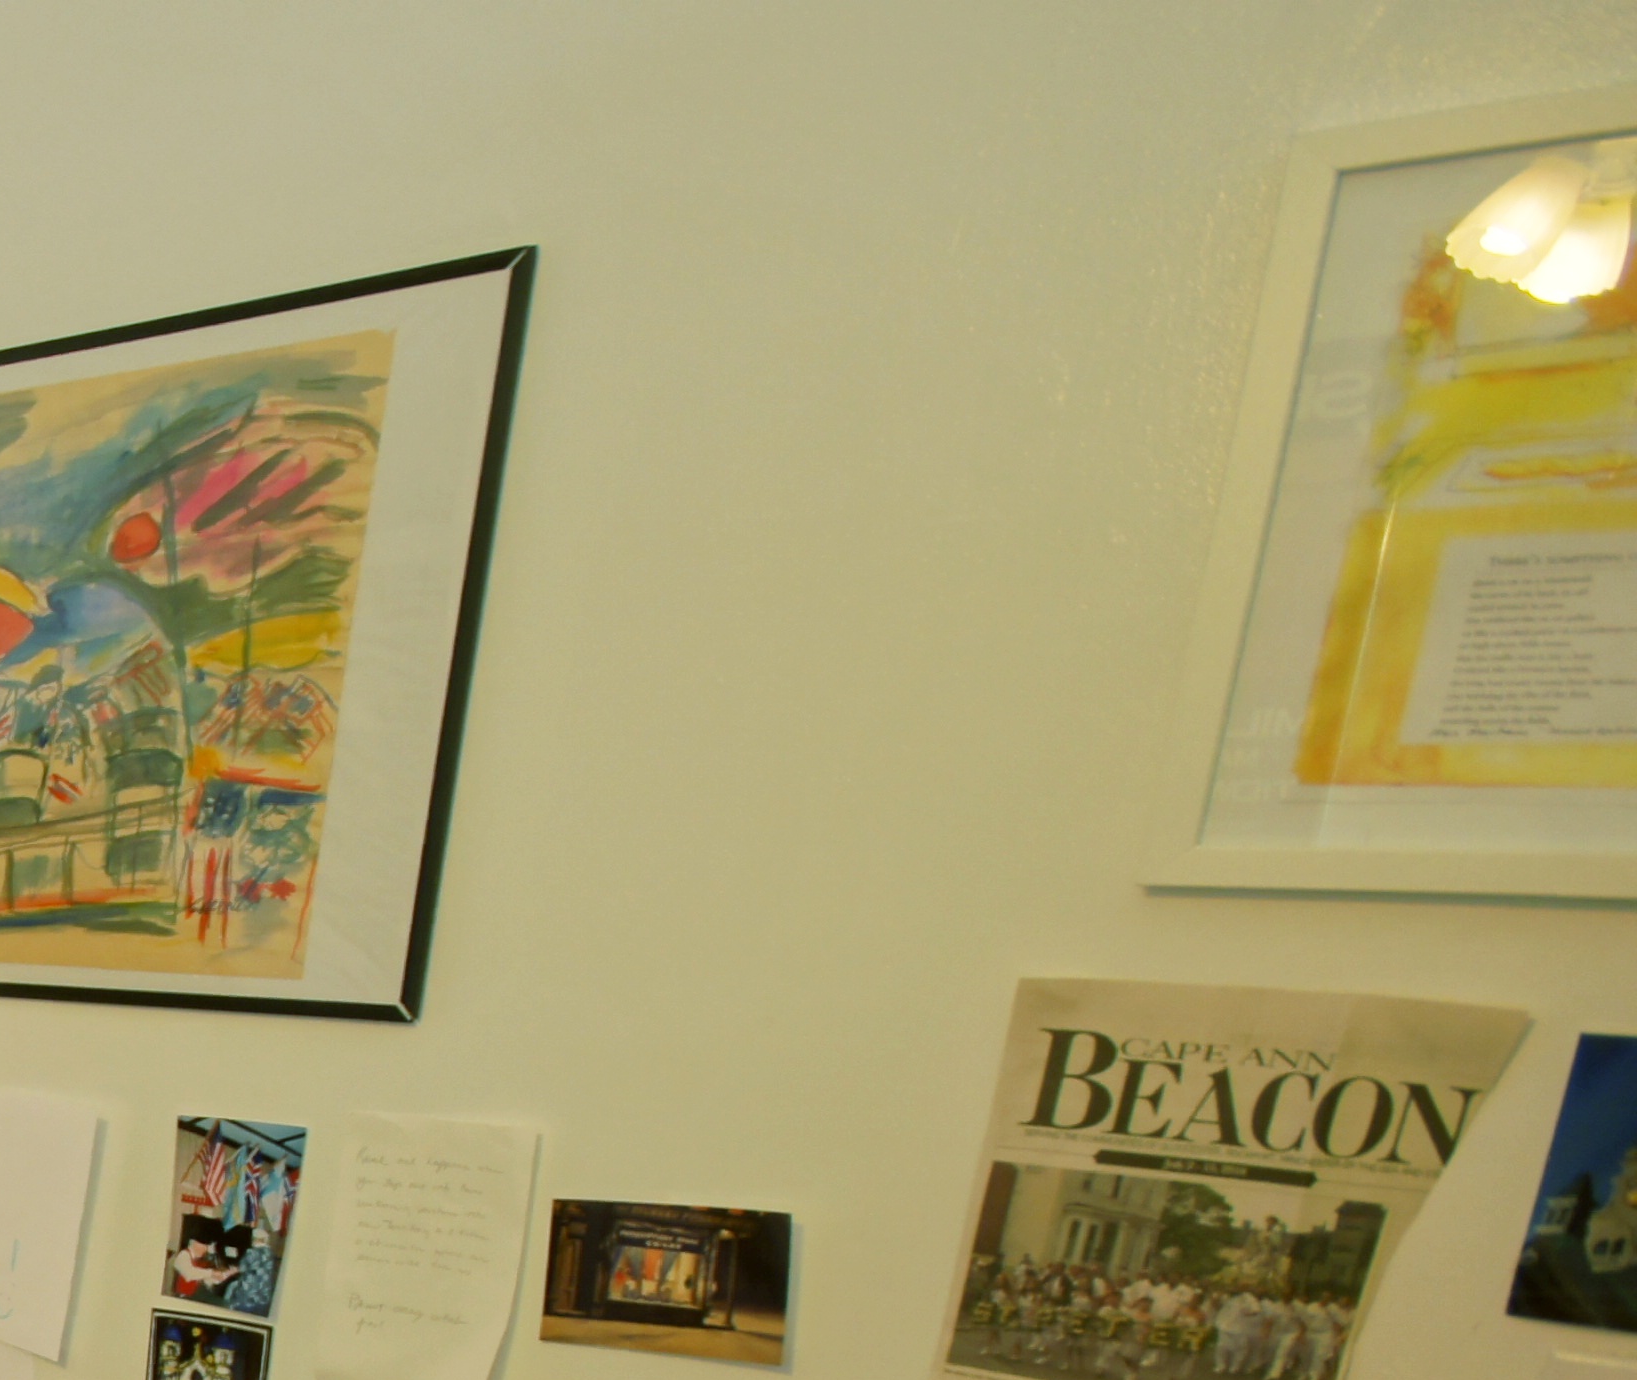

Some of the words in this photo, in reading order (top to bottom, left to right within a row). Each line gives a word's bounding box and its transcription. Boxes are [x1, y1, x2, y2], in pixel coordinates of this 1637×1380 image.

[1018, 1027, 1482, 1167] BEACON
[1119, 1036, 1230, 1065] CAPE
[1240, 1044, 1339, 1073] ANN
